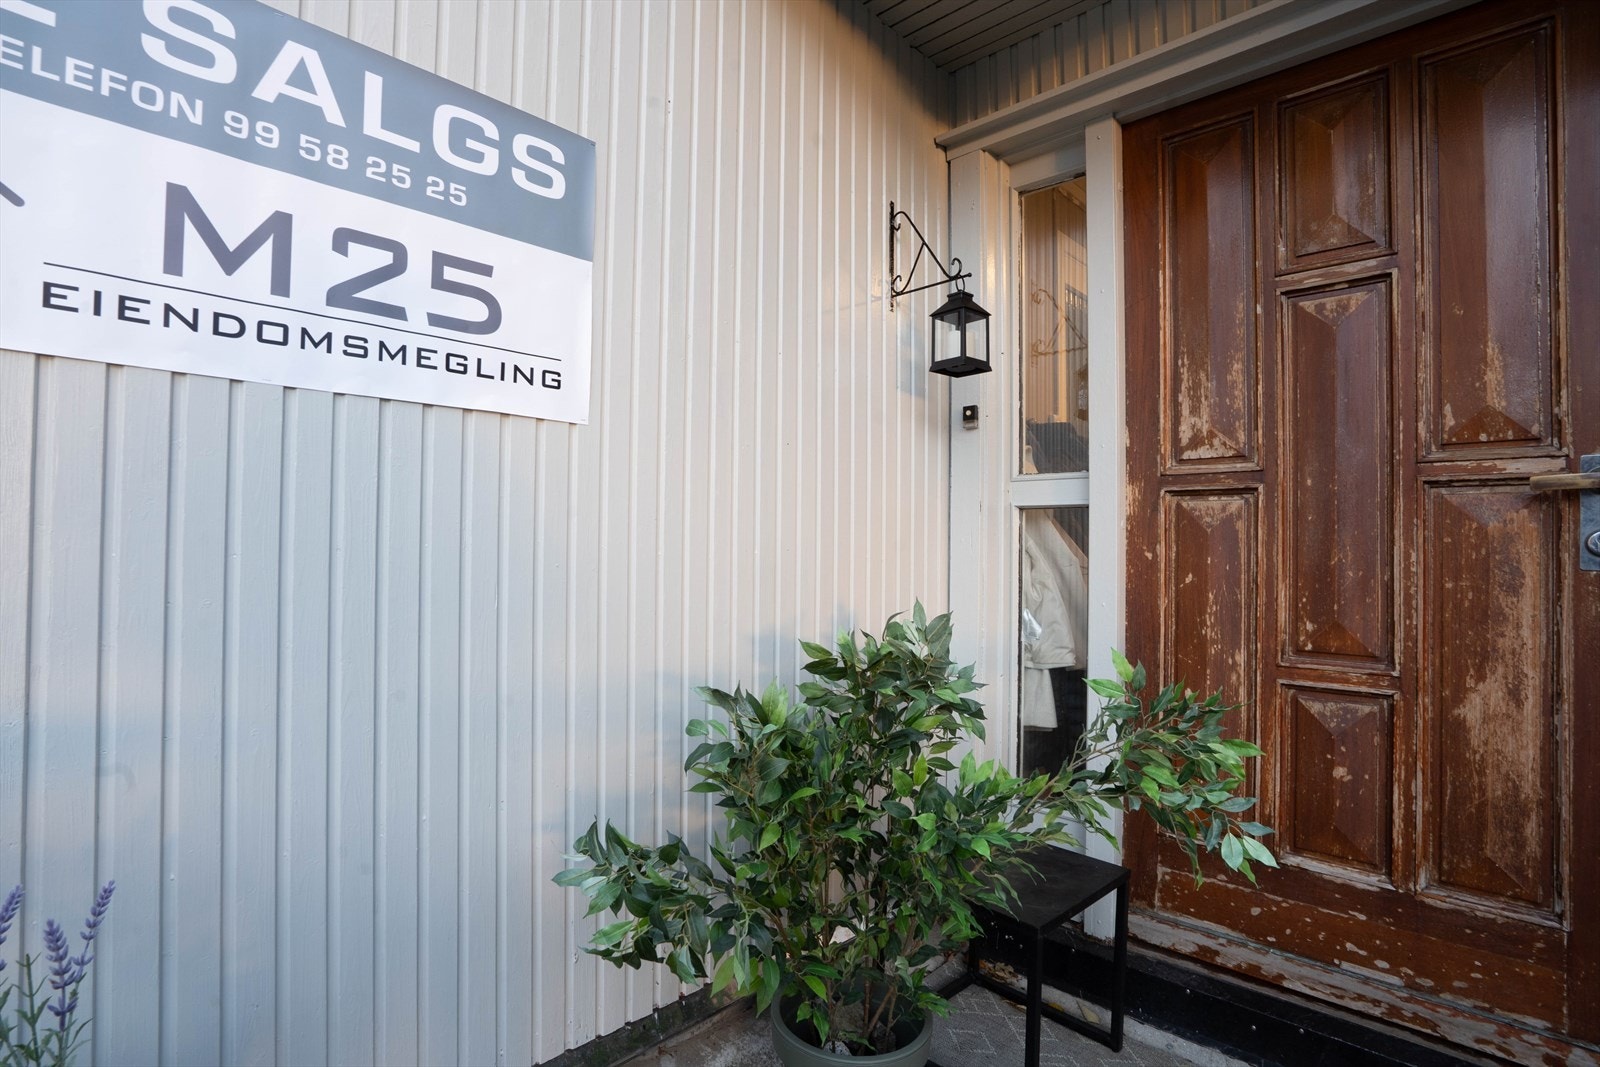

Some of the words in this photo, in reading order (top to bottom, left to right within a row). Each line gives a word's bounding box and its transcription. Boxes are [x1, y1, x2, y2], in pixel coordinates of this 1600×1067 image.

[141, 0, 566, 200] SALGS
[223, 110, 280, 149] 99
[299, 133, 350, 170] 58
[365, 156, 412, 189] 25
[426, 175, 468, 207] 25
[42, 281, 562, 390] EIENDOMSMEGLING
